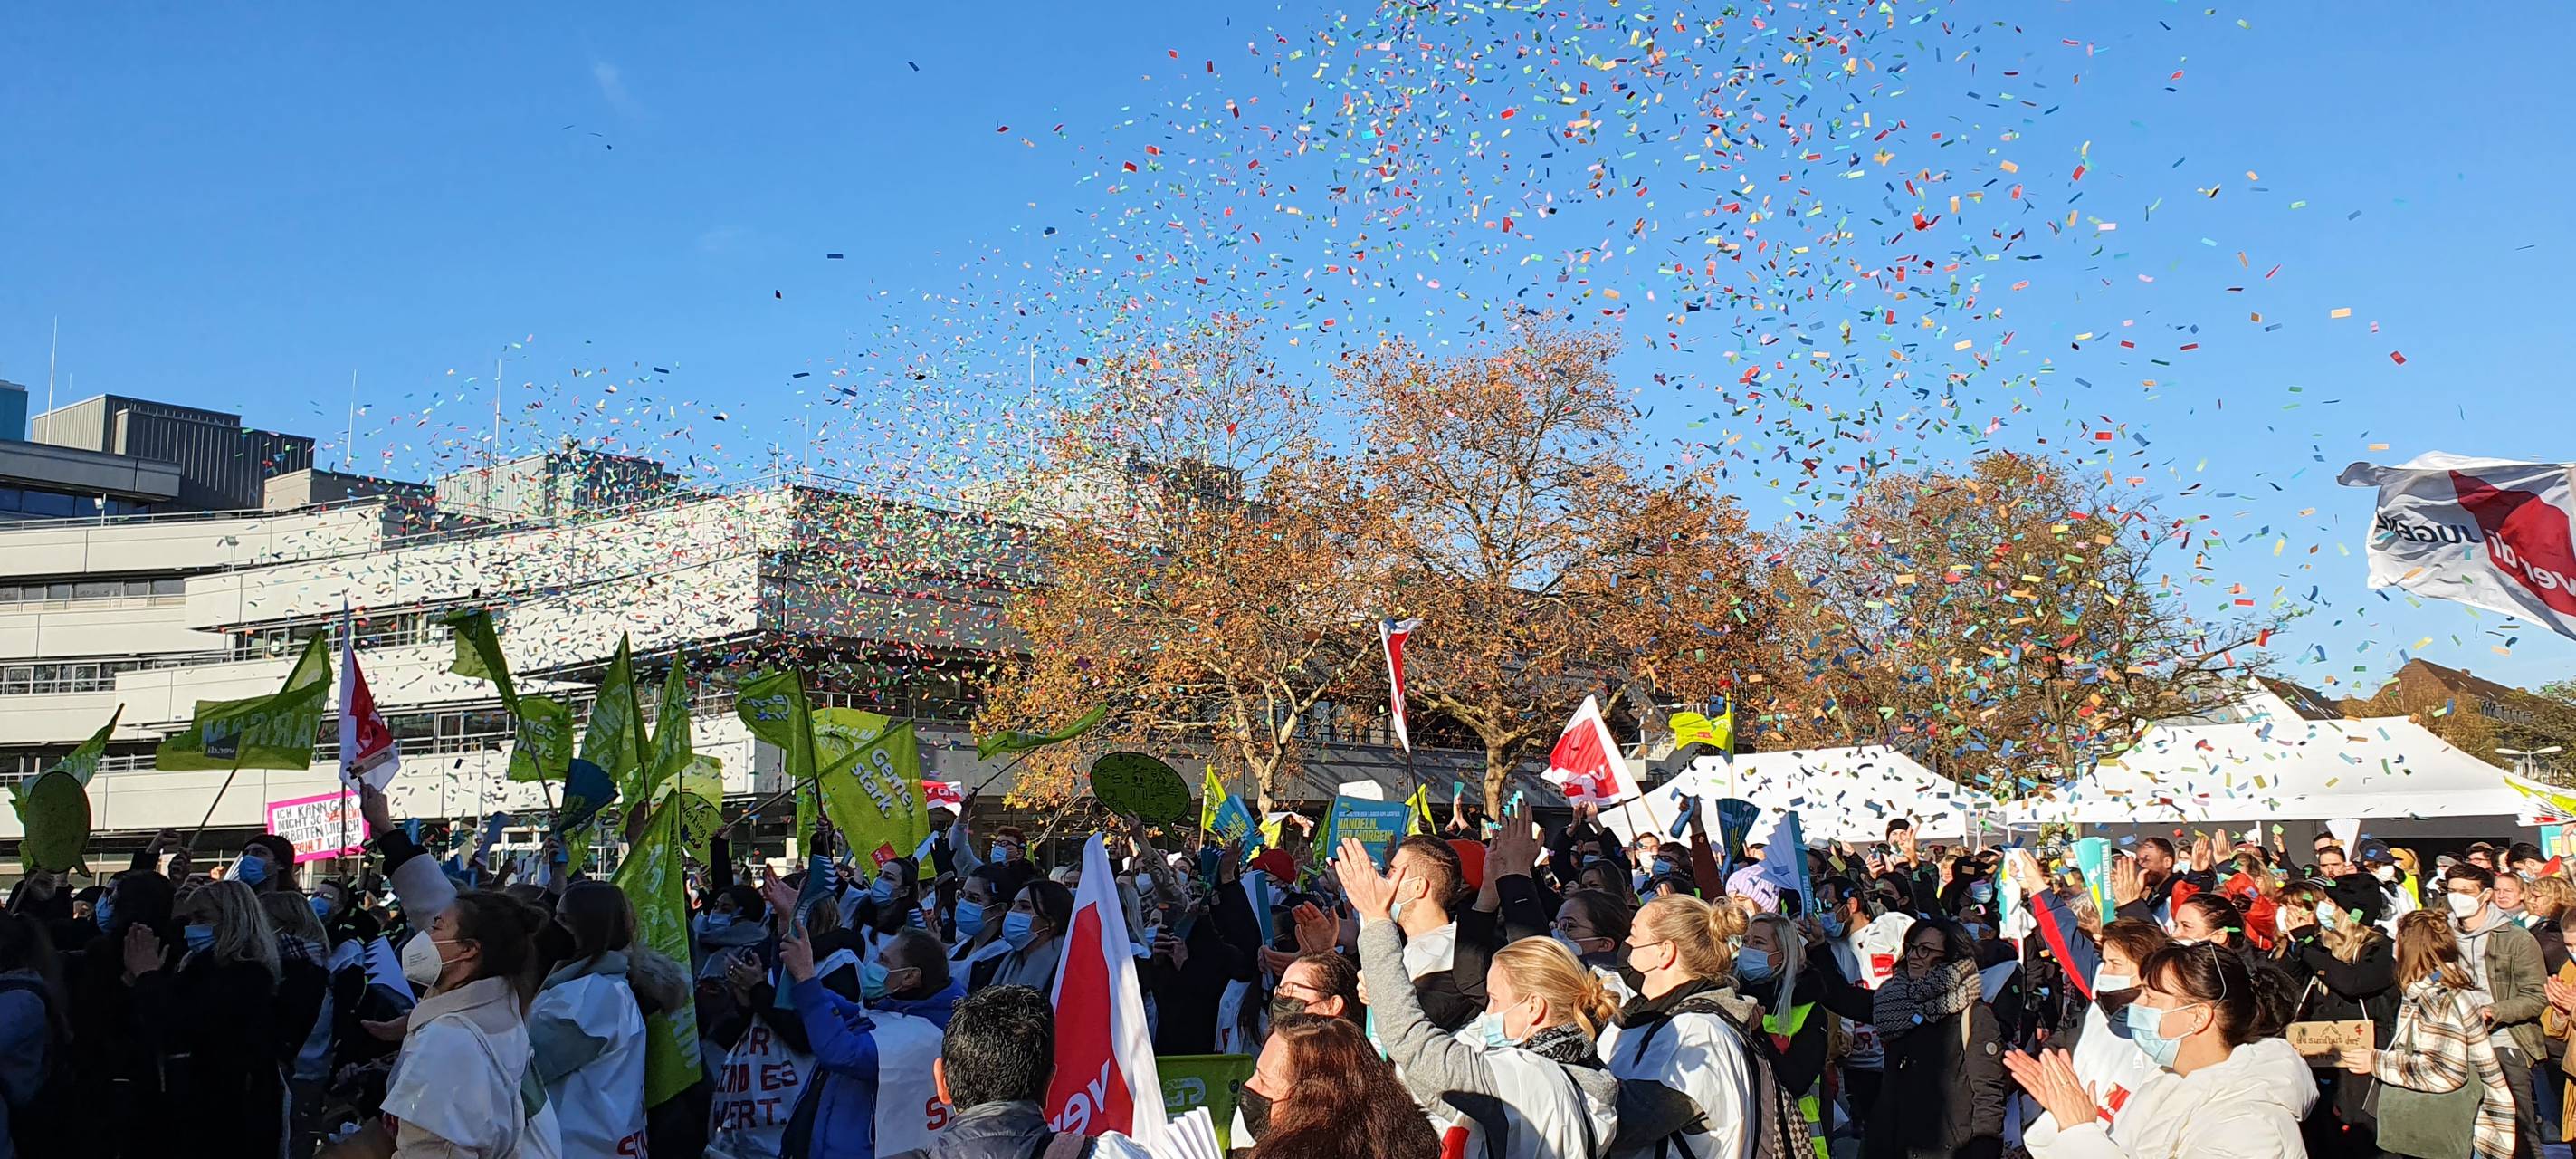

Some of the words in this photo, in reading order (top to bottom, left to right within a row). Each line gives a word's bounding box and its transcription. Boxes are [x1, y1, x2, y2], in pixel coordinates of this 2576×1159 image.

[851, 762, 891, 819] stark.
[277, 808, 292, 819] ICH
[298, 802, 327, 817] KANN
[278, 816, 308, 831] NICHT
[327, 833, 358, 850] WEDE
